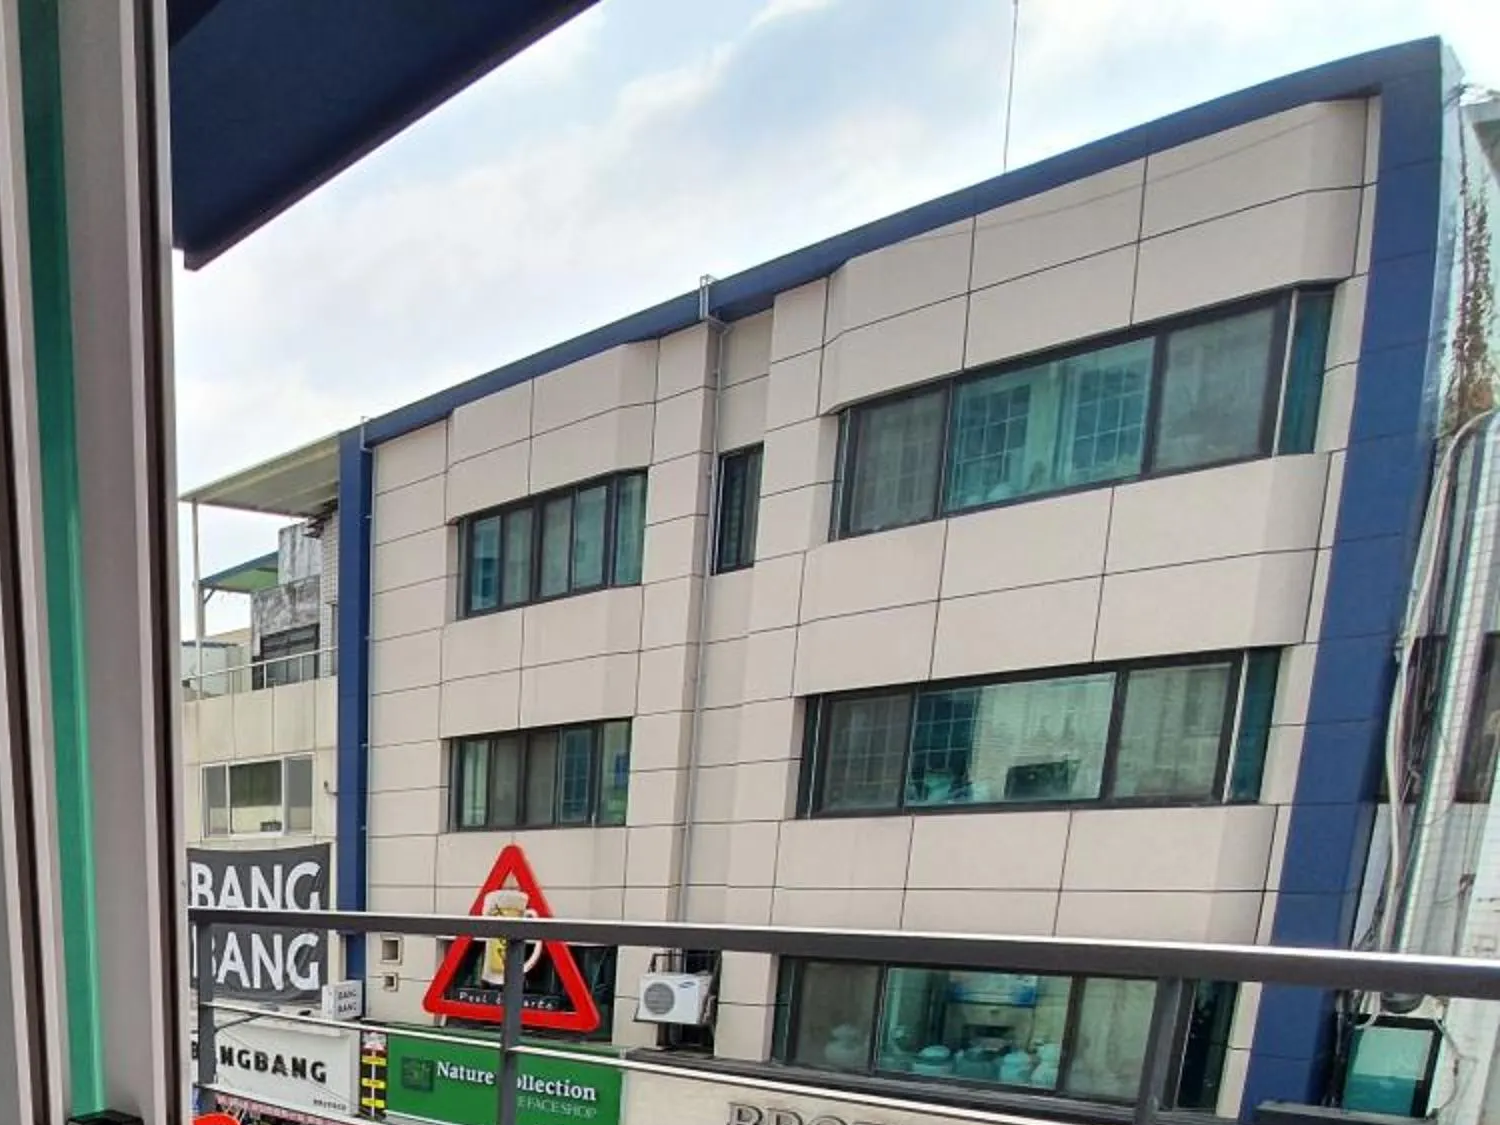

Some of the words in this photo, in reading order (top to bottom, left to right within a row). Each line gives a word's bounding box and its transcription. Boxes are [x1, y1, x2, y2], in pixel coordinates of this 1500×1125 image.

[190, 861, 321, 911] BANG
[436, 1061, 495, 1085] Nature
[515, 1072, 597, 1101] llection
